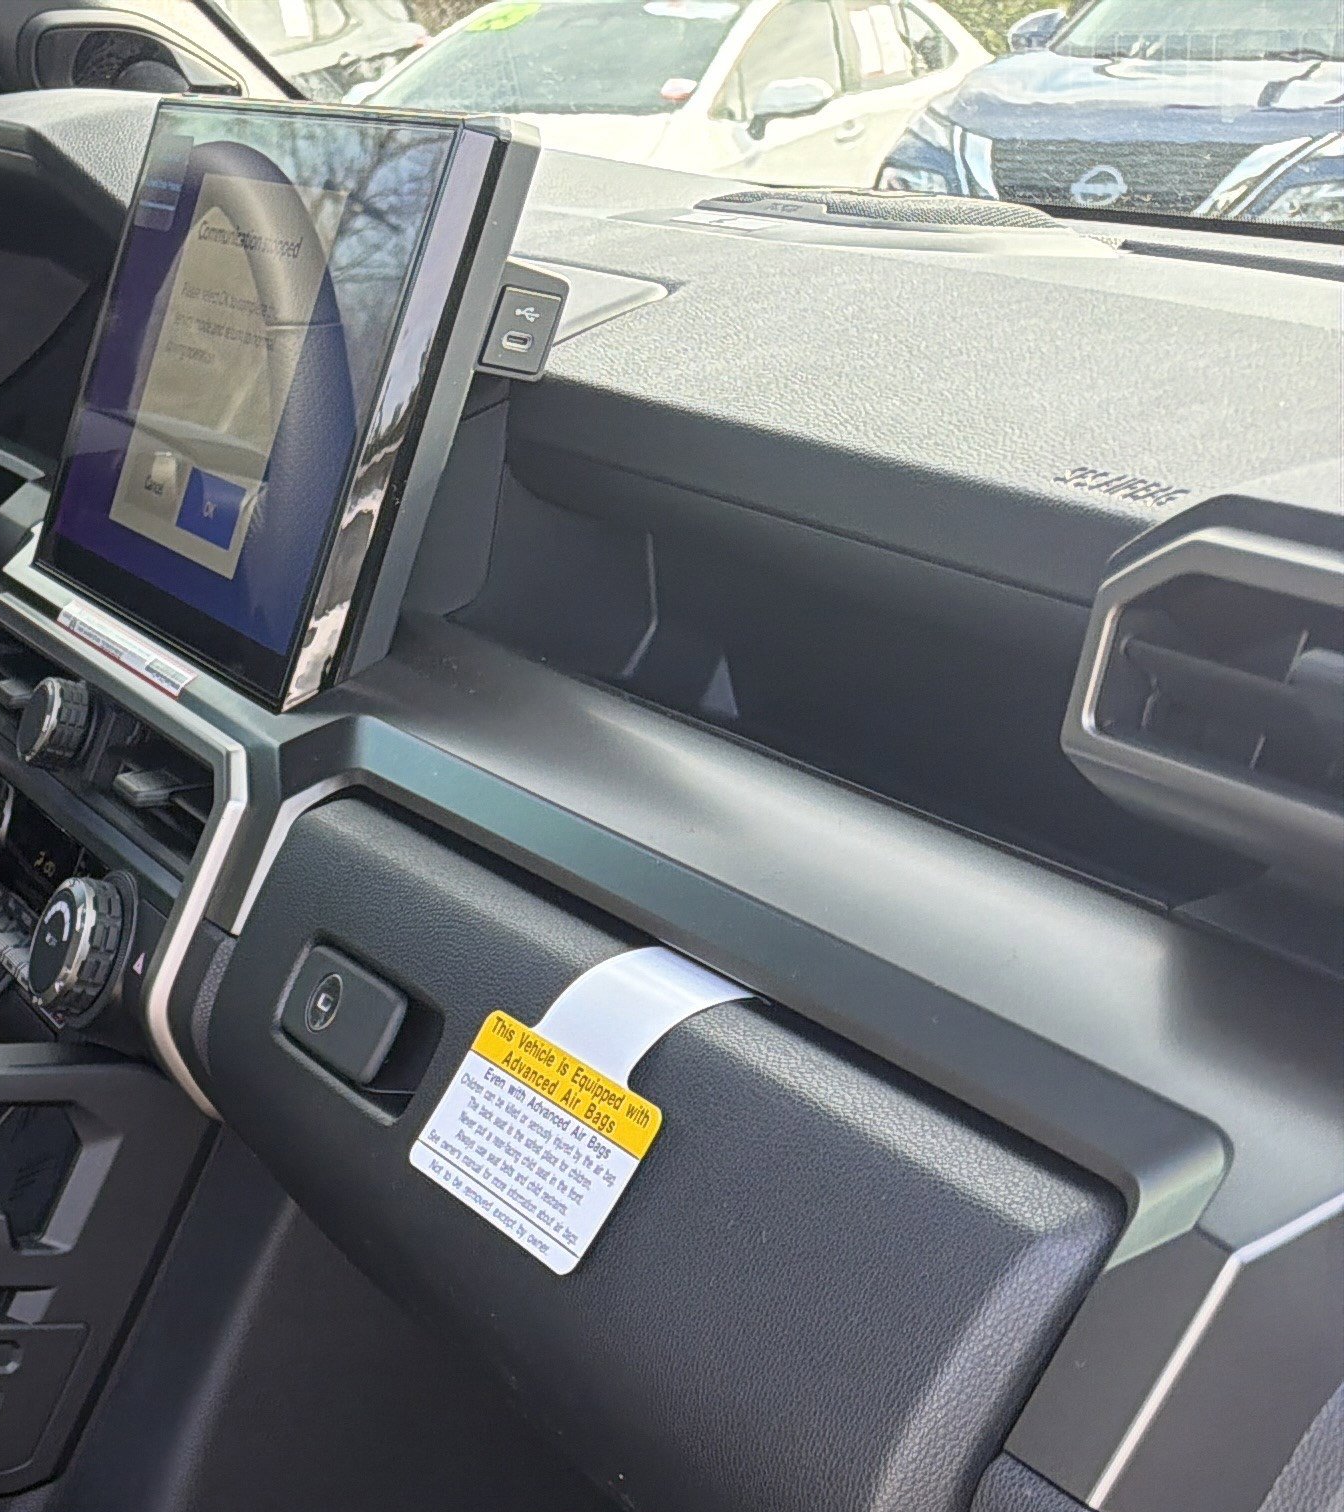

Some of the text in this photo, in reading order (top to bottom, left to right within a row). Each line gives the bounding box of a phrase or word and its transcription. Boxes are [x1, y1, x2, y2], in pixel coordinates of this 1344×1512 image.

[482, 1066, 613, 1162] Even with Advanced Air Bags
[489, 1015, 653, 1128] This Vehicle is Equipped with
[500, 1049, 619, 1136] Advanced Air Bags
